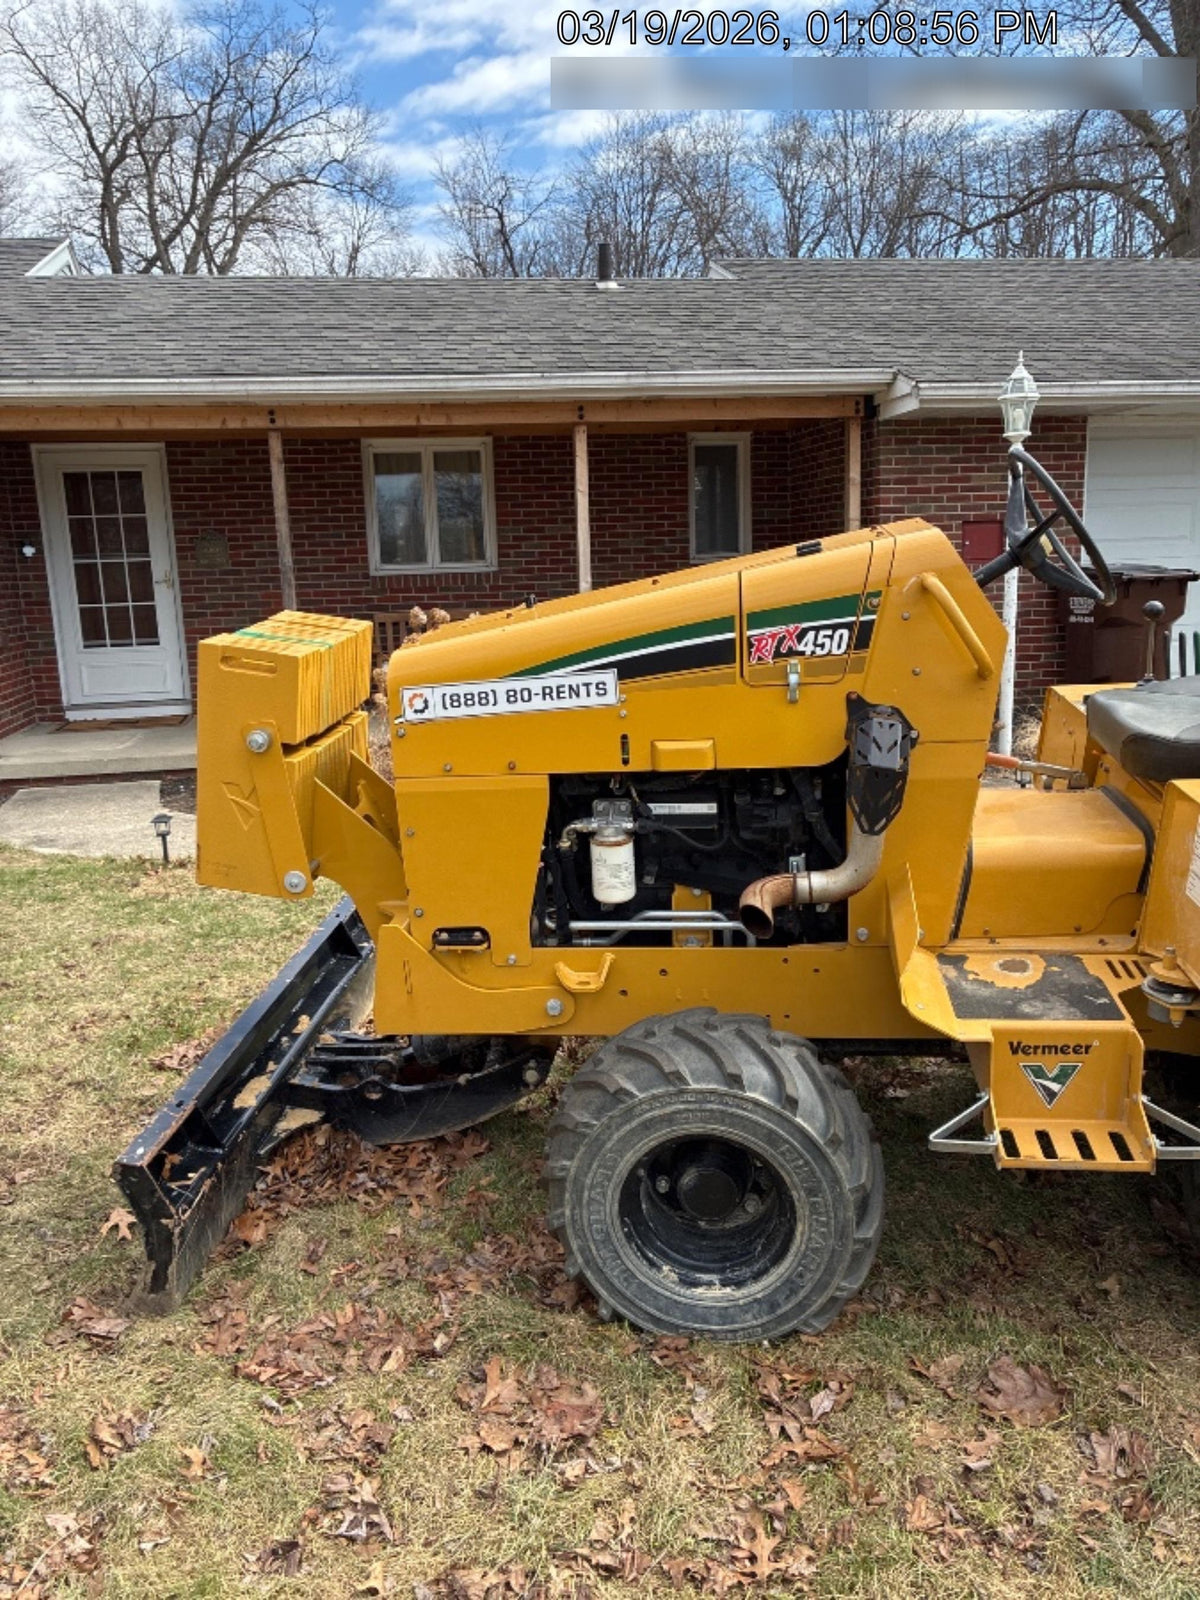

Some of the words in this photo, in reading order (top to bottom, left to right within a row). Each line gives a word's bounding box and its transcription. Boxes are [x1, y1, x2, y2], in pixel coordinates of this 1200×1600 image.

[441, 689, 498, 711] (888)
[505, 681, 608, 705] 80-RENTS
[1008, 1040, 1093, 1056] Vermeer
